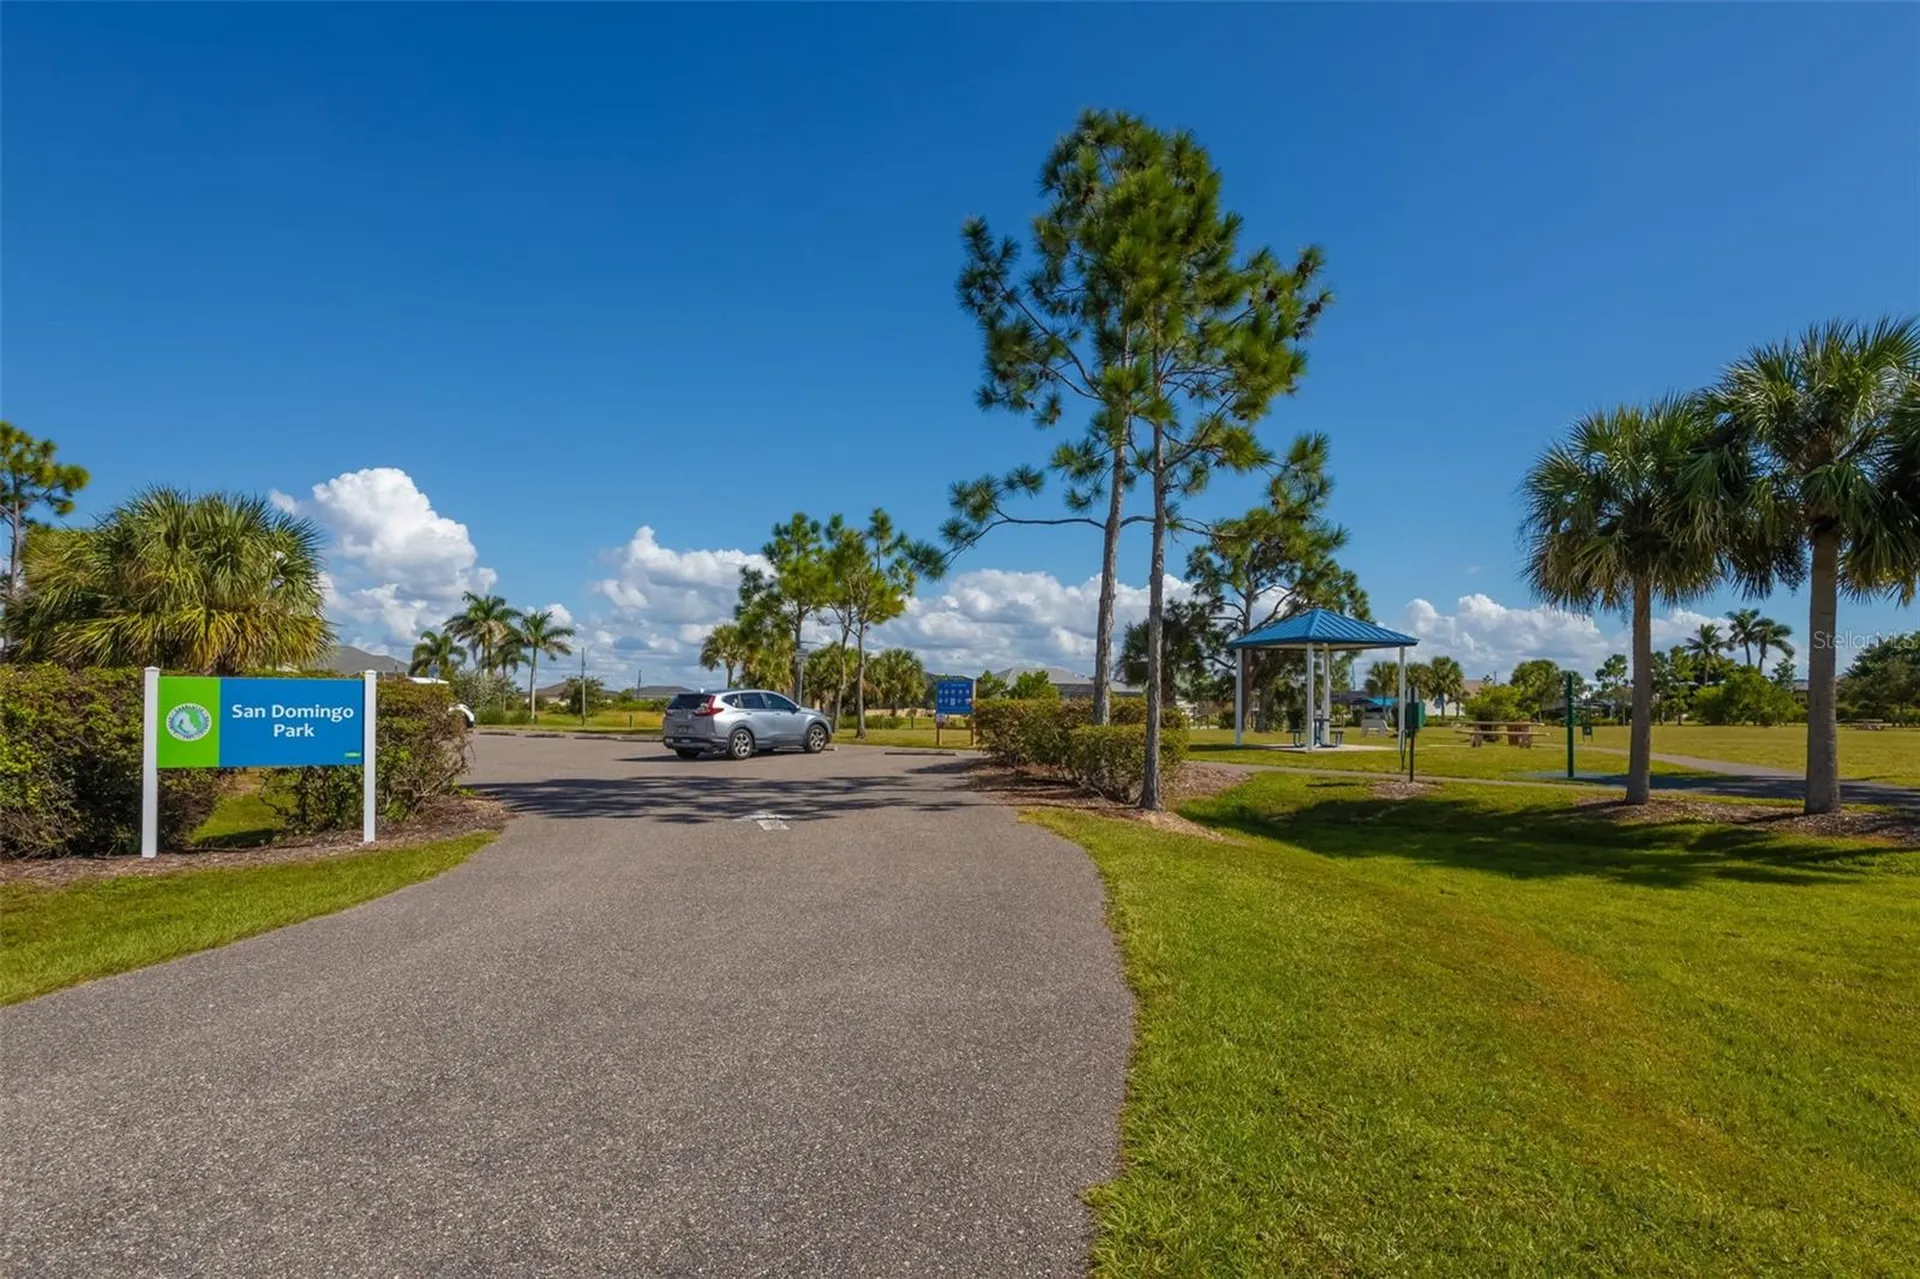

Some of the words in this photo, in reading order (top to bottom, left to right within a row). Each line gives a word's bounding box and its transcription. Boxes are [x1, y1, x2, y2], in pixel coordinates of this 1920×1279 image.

[231, 703, 266, 719] San
[271, 703, 355, 723] Domingo
[273, 723, 316, 738] Park
